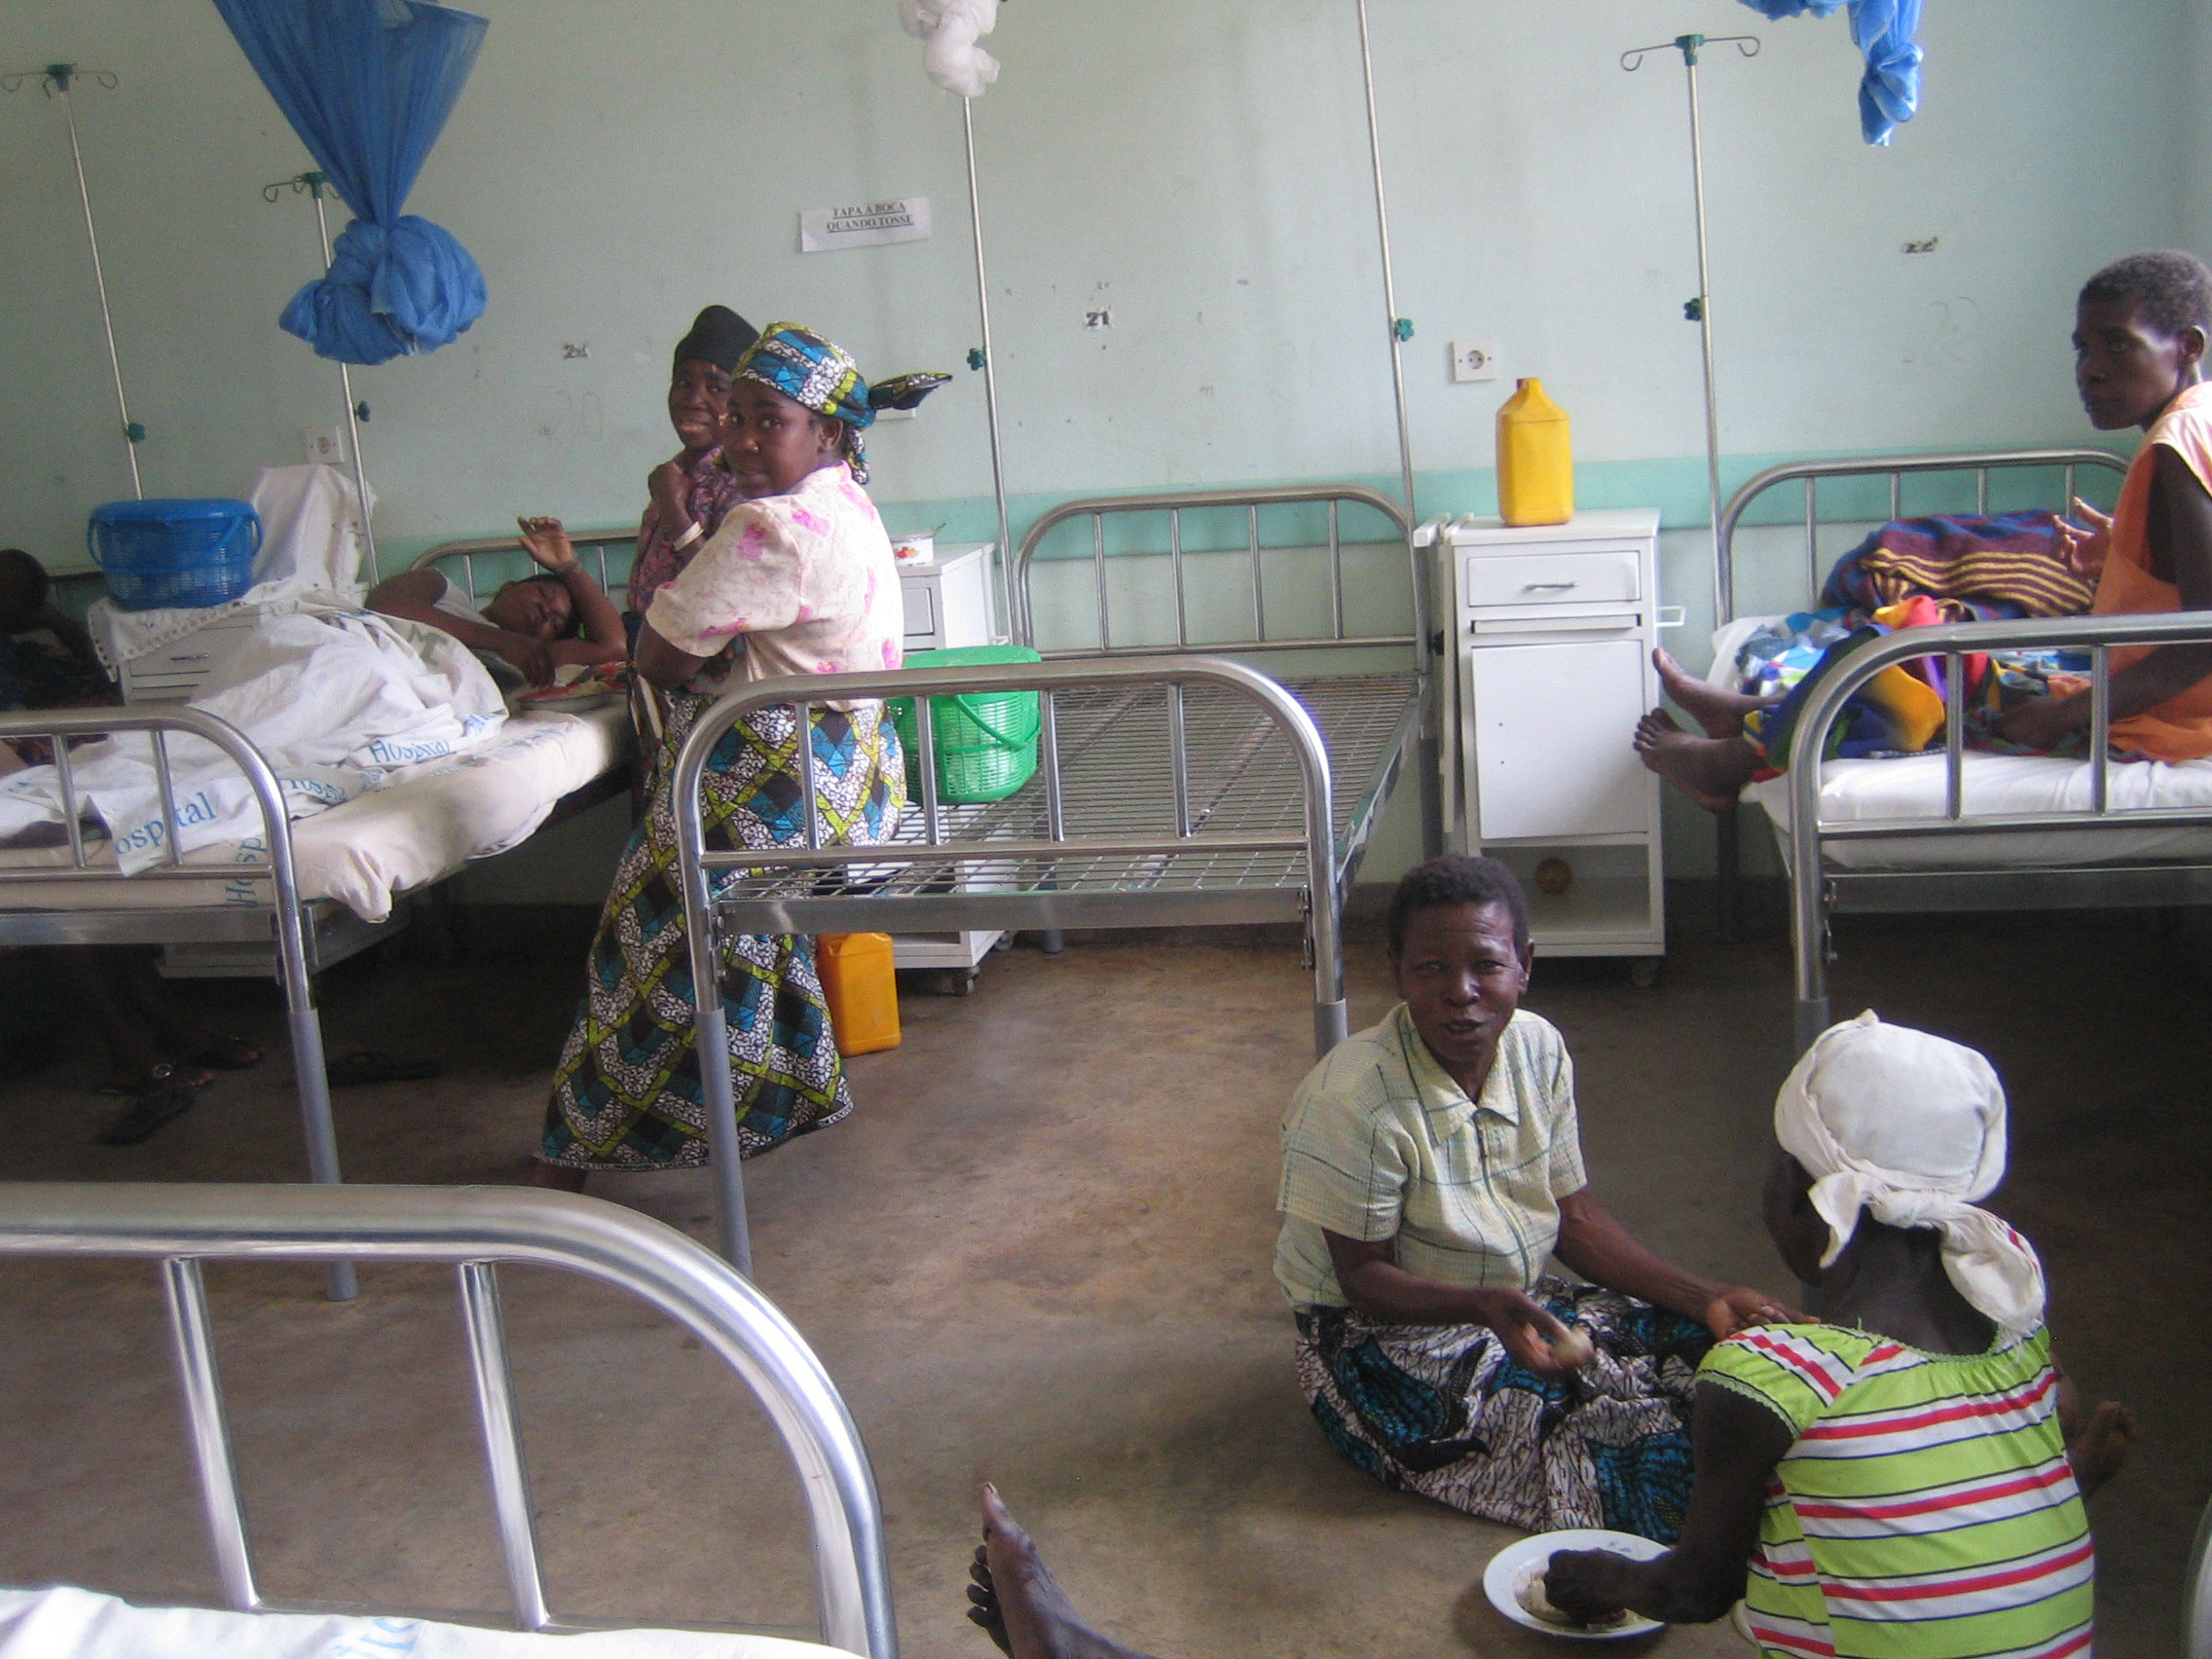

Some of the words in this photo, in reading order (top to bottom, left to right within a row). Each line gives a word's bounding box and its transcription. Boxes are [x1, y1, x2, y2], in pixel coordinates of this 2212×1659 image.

[833, 205, 864, 218] TAPA
[874, 202, 906, 213] BOCA
[827, 218, 877, 232] QUANDO
[878, 213, 914, 227] TOSSE
[1086, 311, 1110, 327] 21
[114, 791, 217, 856] osptal
